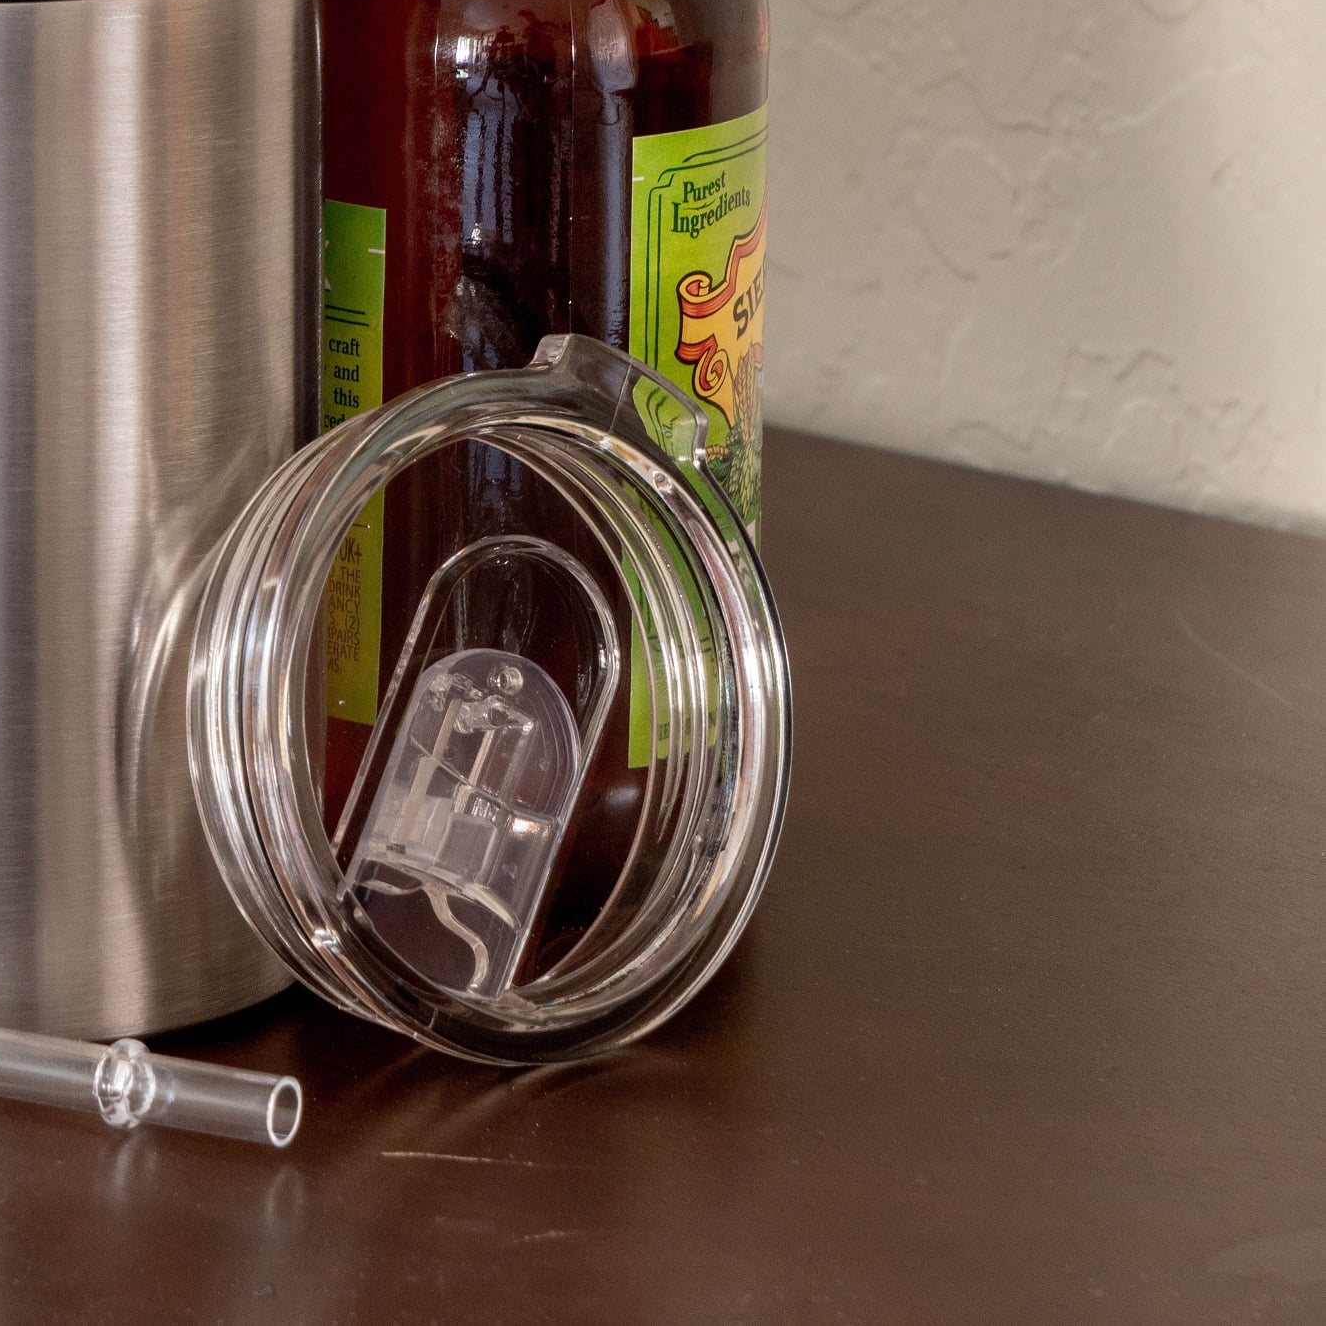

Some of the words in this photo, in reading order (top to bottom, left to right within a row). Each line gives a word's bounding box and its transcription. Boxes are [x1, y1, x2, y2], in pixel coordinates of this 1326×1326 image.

[682, 170, 726, 204] Purest
[671, 185, 751, 239] Ingredients
[329, 337, 360, 357] craft
[334, 365, 359, 382] and
[334, 387, 359, 408] this
[340, 566, 361, 584] THE
[329, 579, 361, 599] DRINK
[345, 615, 360, 635] (2)
